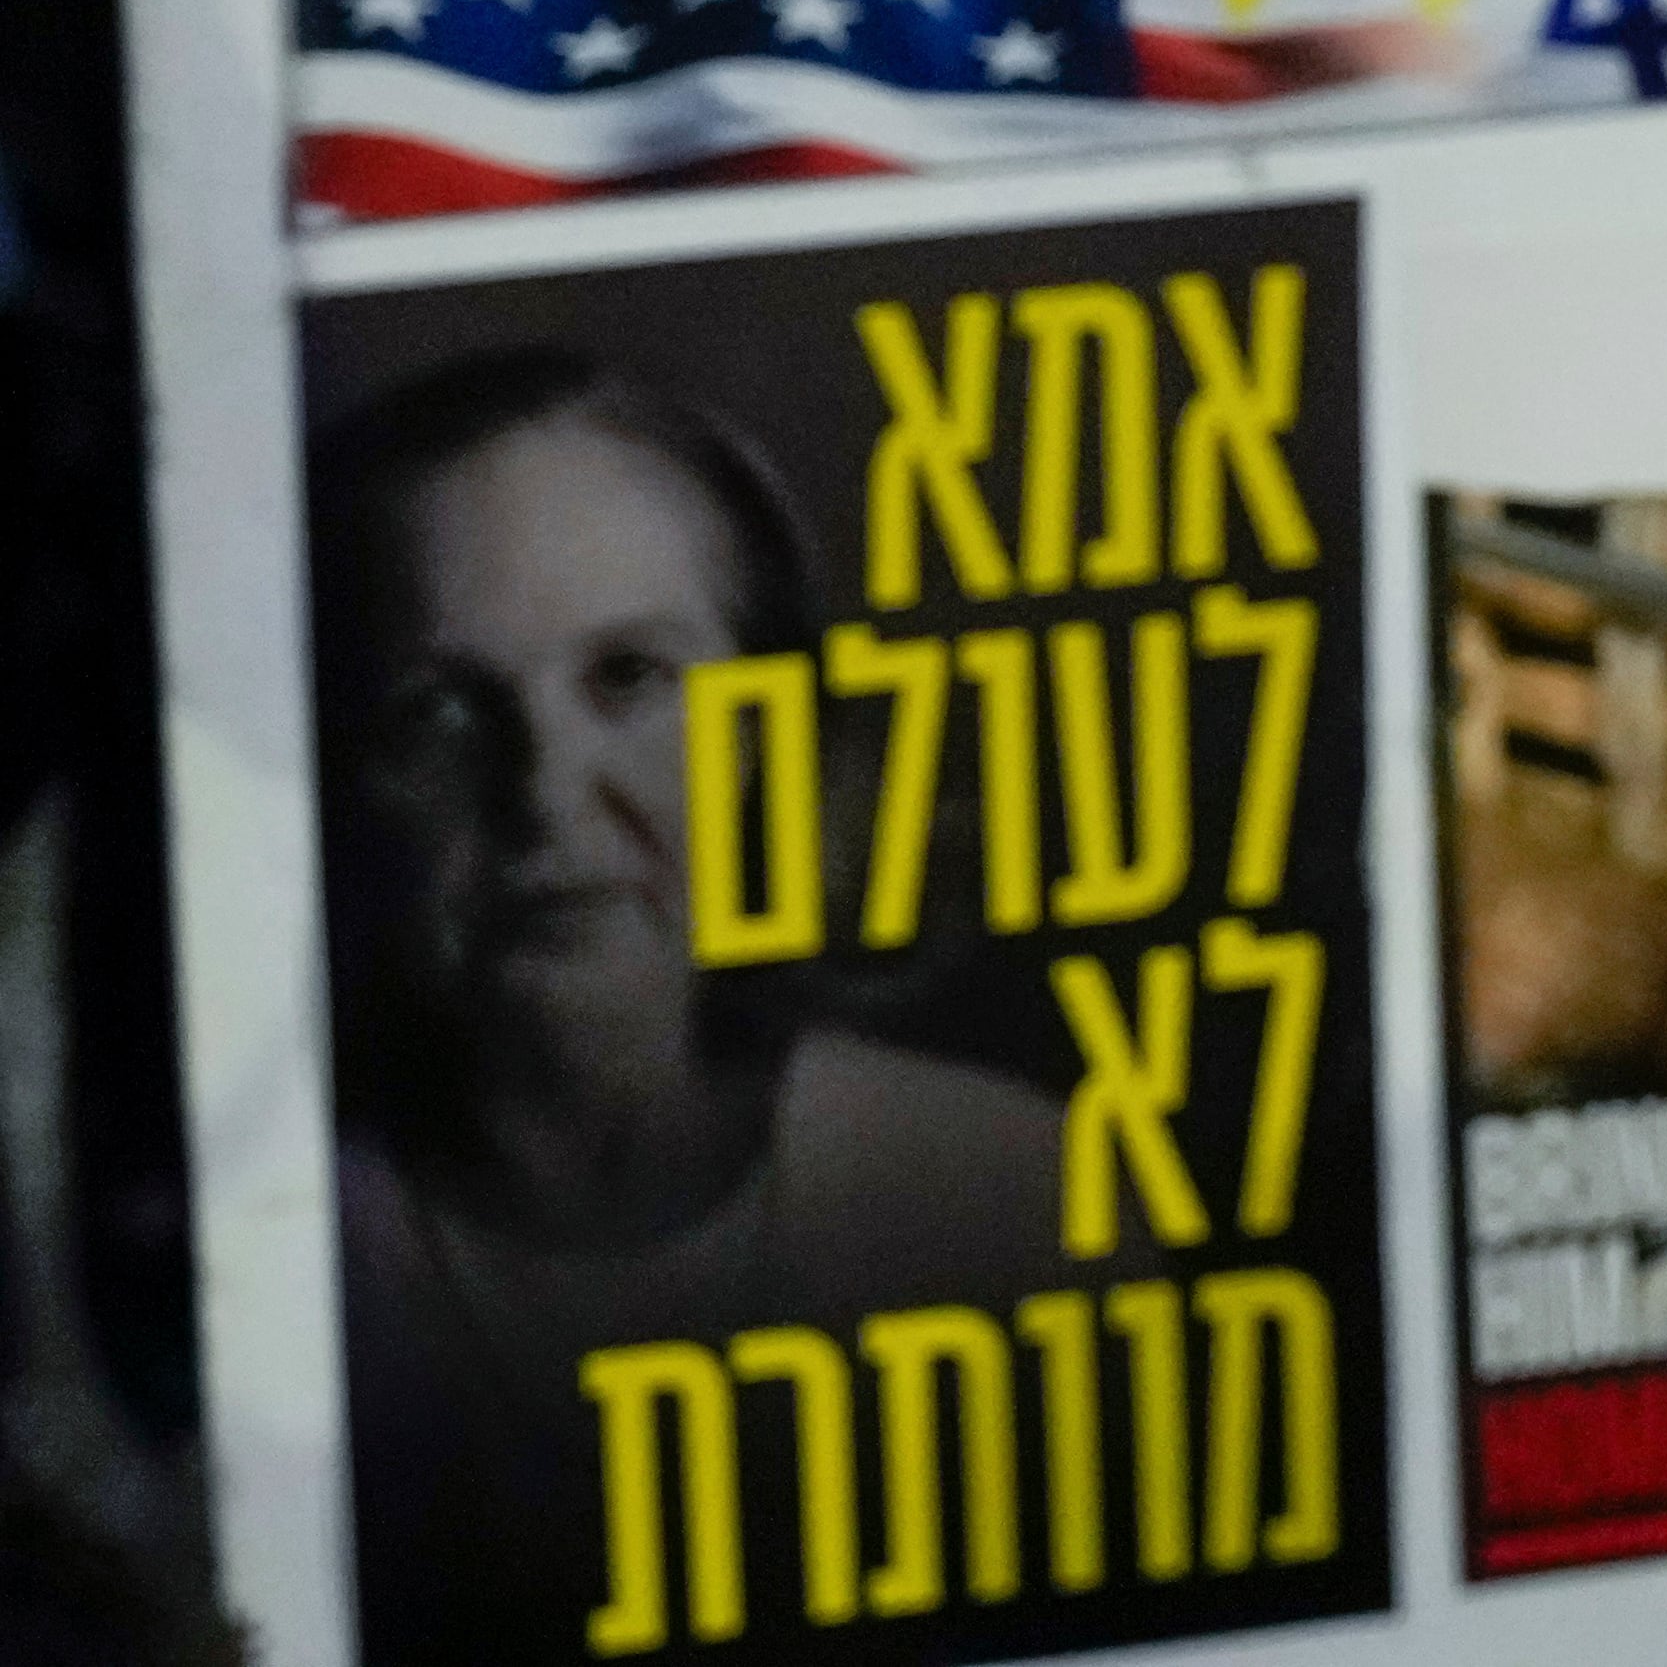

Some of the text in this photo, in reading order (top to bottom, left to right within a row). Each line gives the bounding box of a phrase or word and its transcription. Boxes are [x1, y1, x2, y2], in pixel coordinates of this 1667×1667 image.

[862, 266, 1314, 608] אמא
[680, 588, 1316, 966] לעולם
[1056, 919, 1320, 1257] לא
[582, 1270, 1336, 1650] מוותרת
